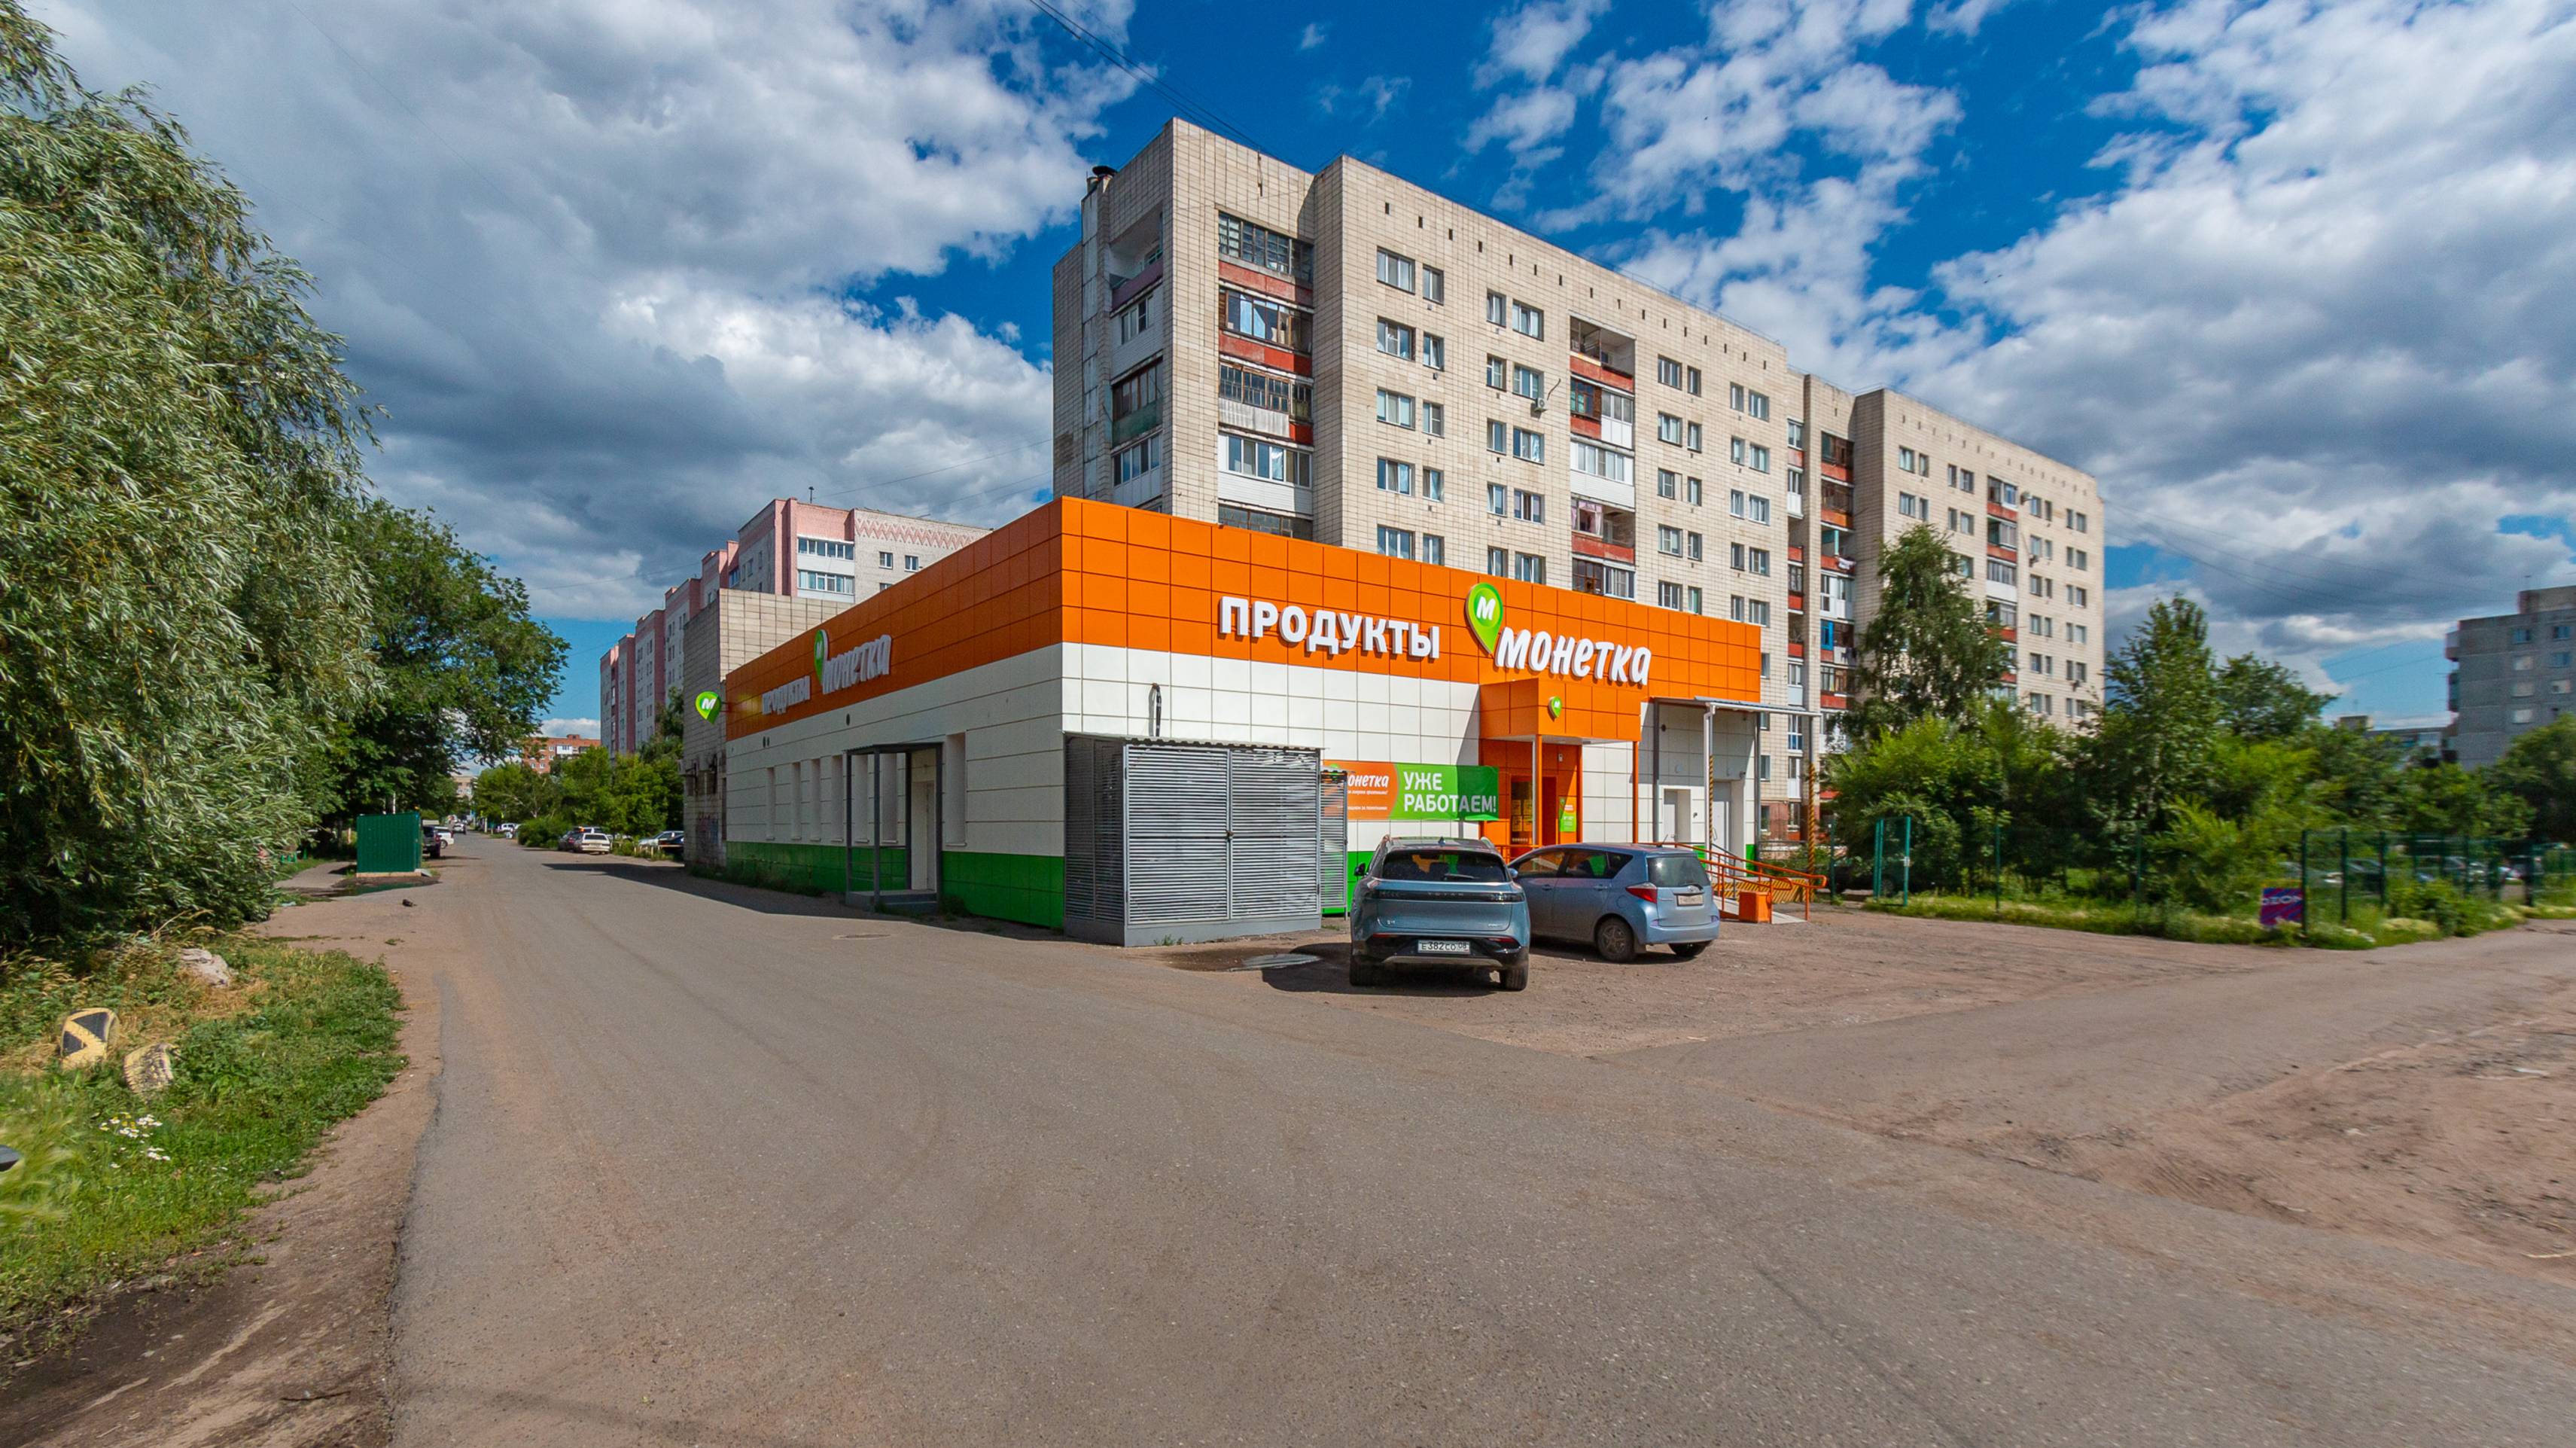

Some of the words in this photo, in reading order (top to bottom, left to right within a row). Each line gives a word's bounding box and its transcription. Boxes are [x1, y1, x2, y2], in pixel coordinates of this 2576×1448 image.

[1219, 596, 1440, 660] ПРОДУКТЫ
[762, 675, 811, 715] ПРОДУКТЫ
[1347, 774, 1390, 788] онетка
[1403, 771, 1442, 791] УЖЕ
[1404, 793, 1497, 812] РАБОТАЕМ!
